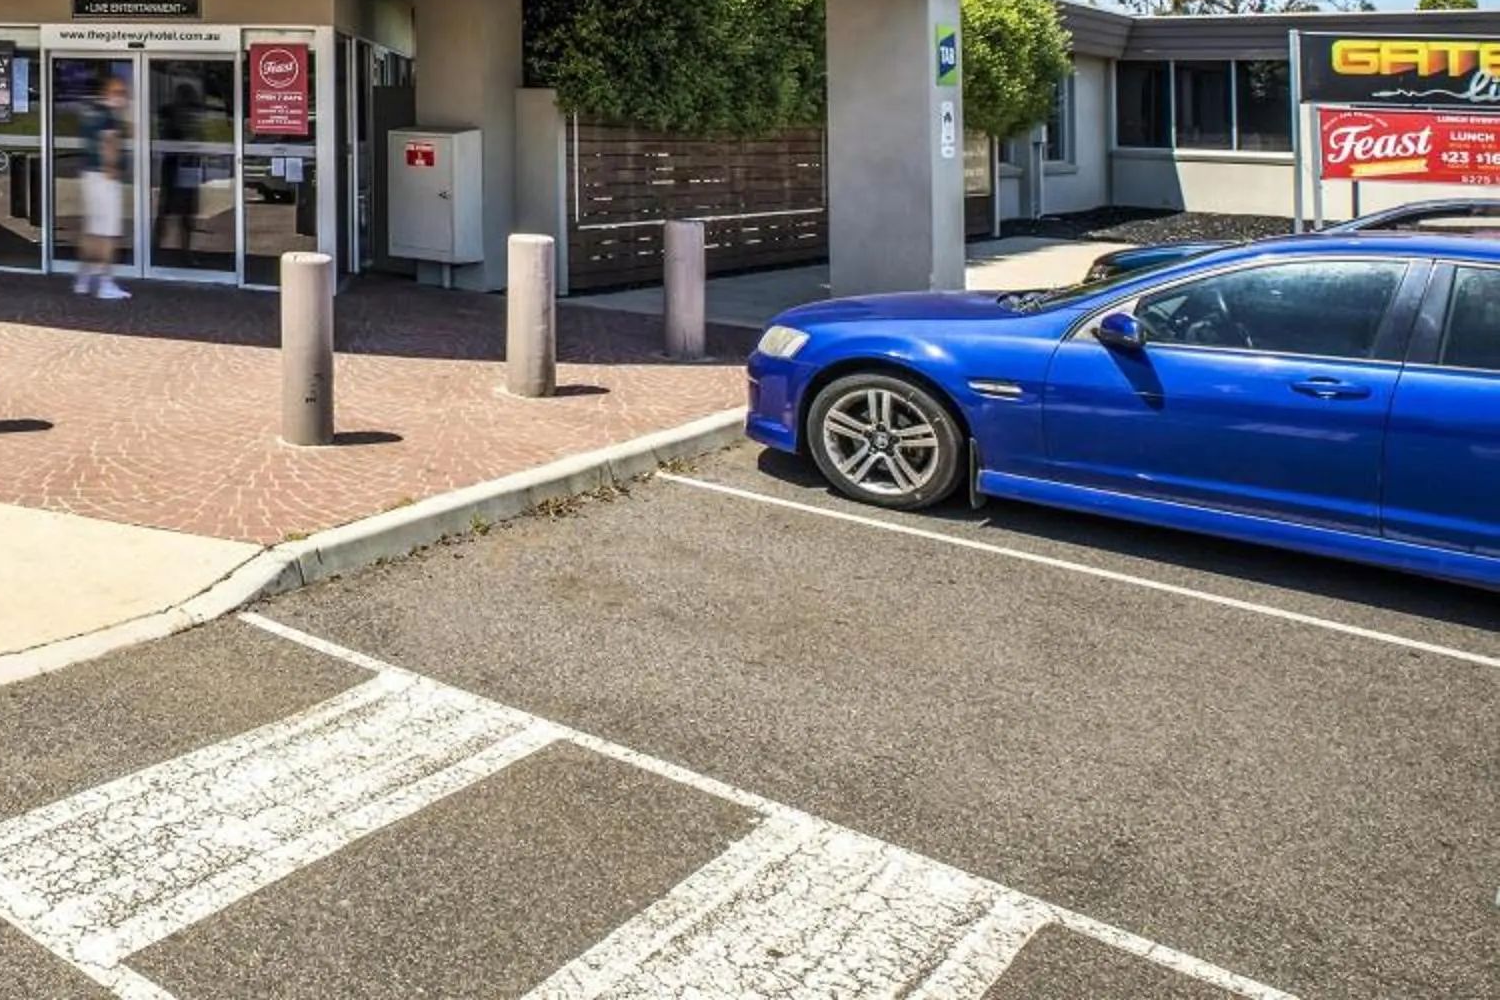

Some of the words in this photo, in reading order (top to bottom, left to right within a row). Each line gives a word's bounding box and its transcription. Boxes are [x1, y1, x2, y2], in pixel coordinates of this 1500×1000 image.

[110, 3, 181, 13] ENTERTAINMENT
[59, 30, 221, 42] www.thegatewayhotel.com.au
[1451, 131, 1495, 142] LUNCH
[1328, 123, 1433, 163] Feast
[1441, 151, 1469, 164] $23
